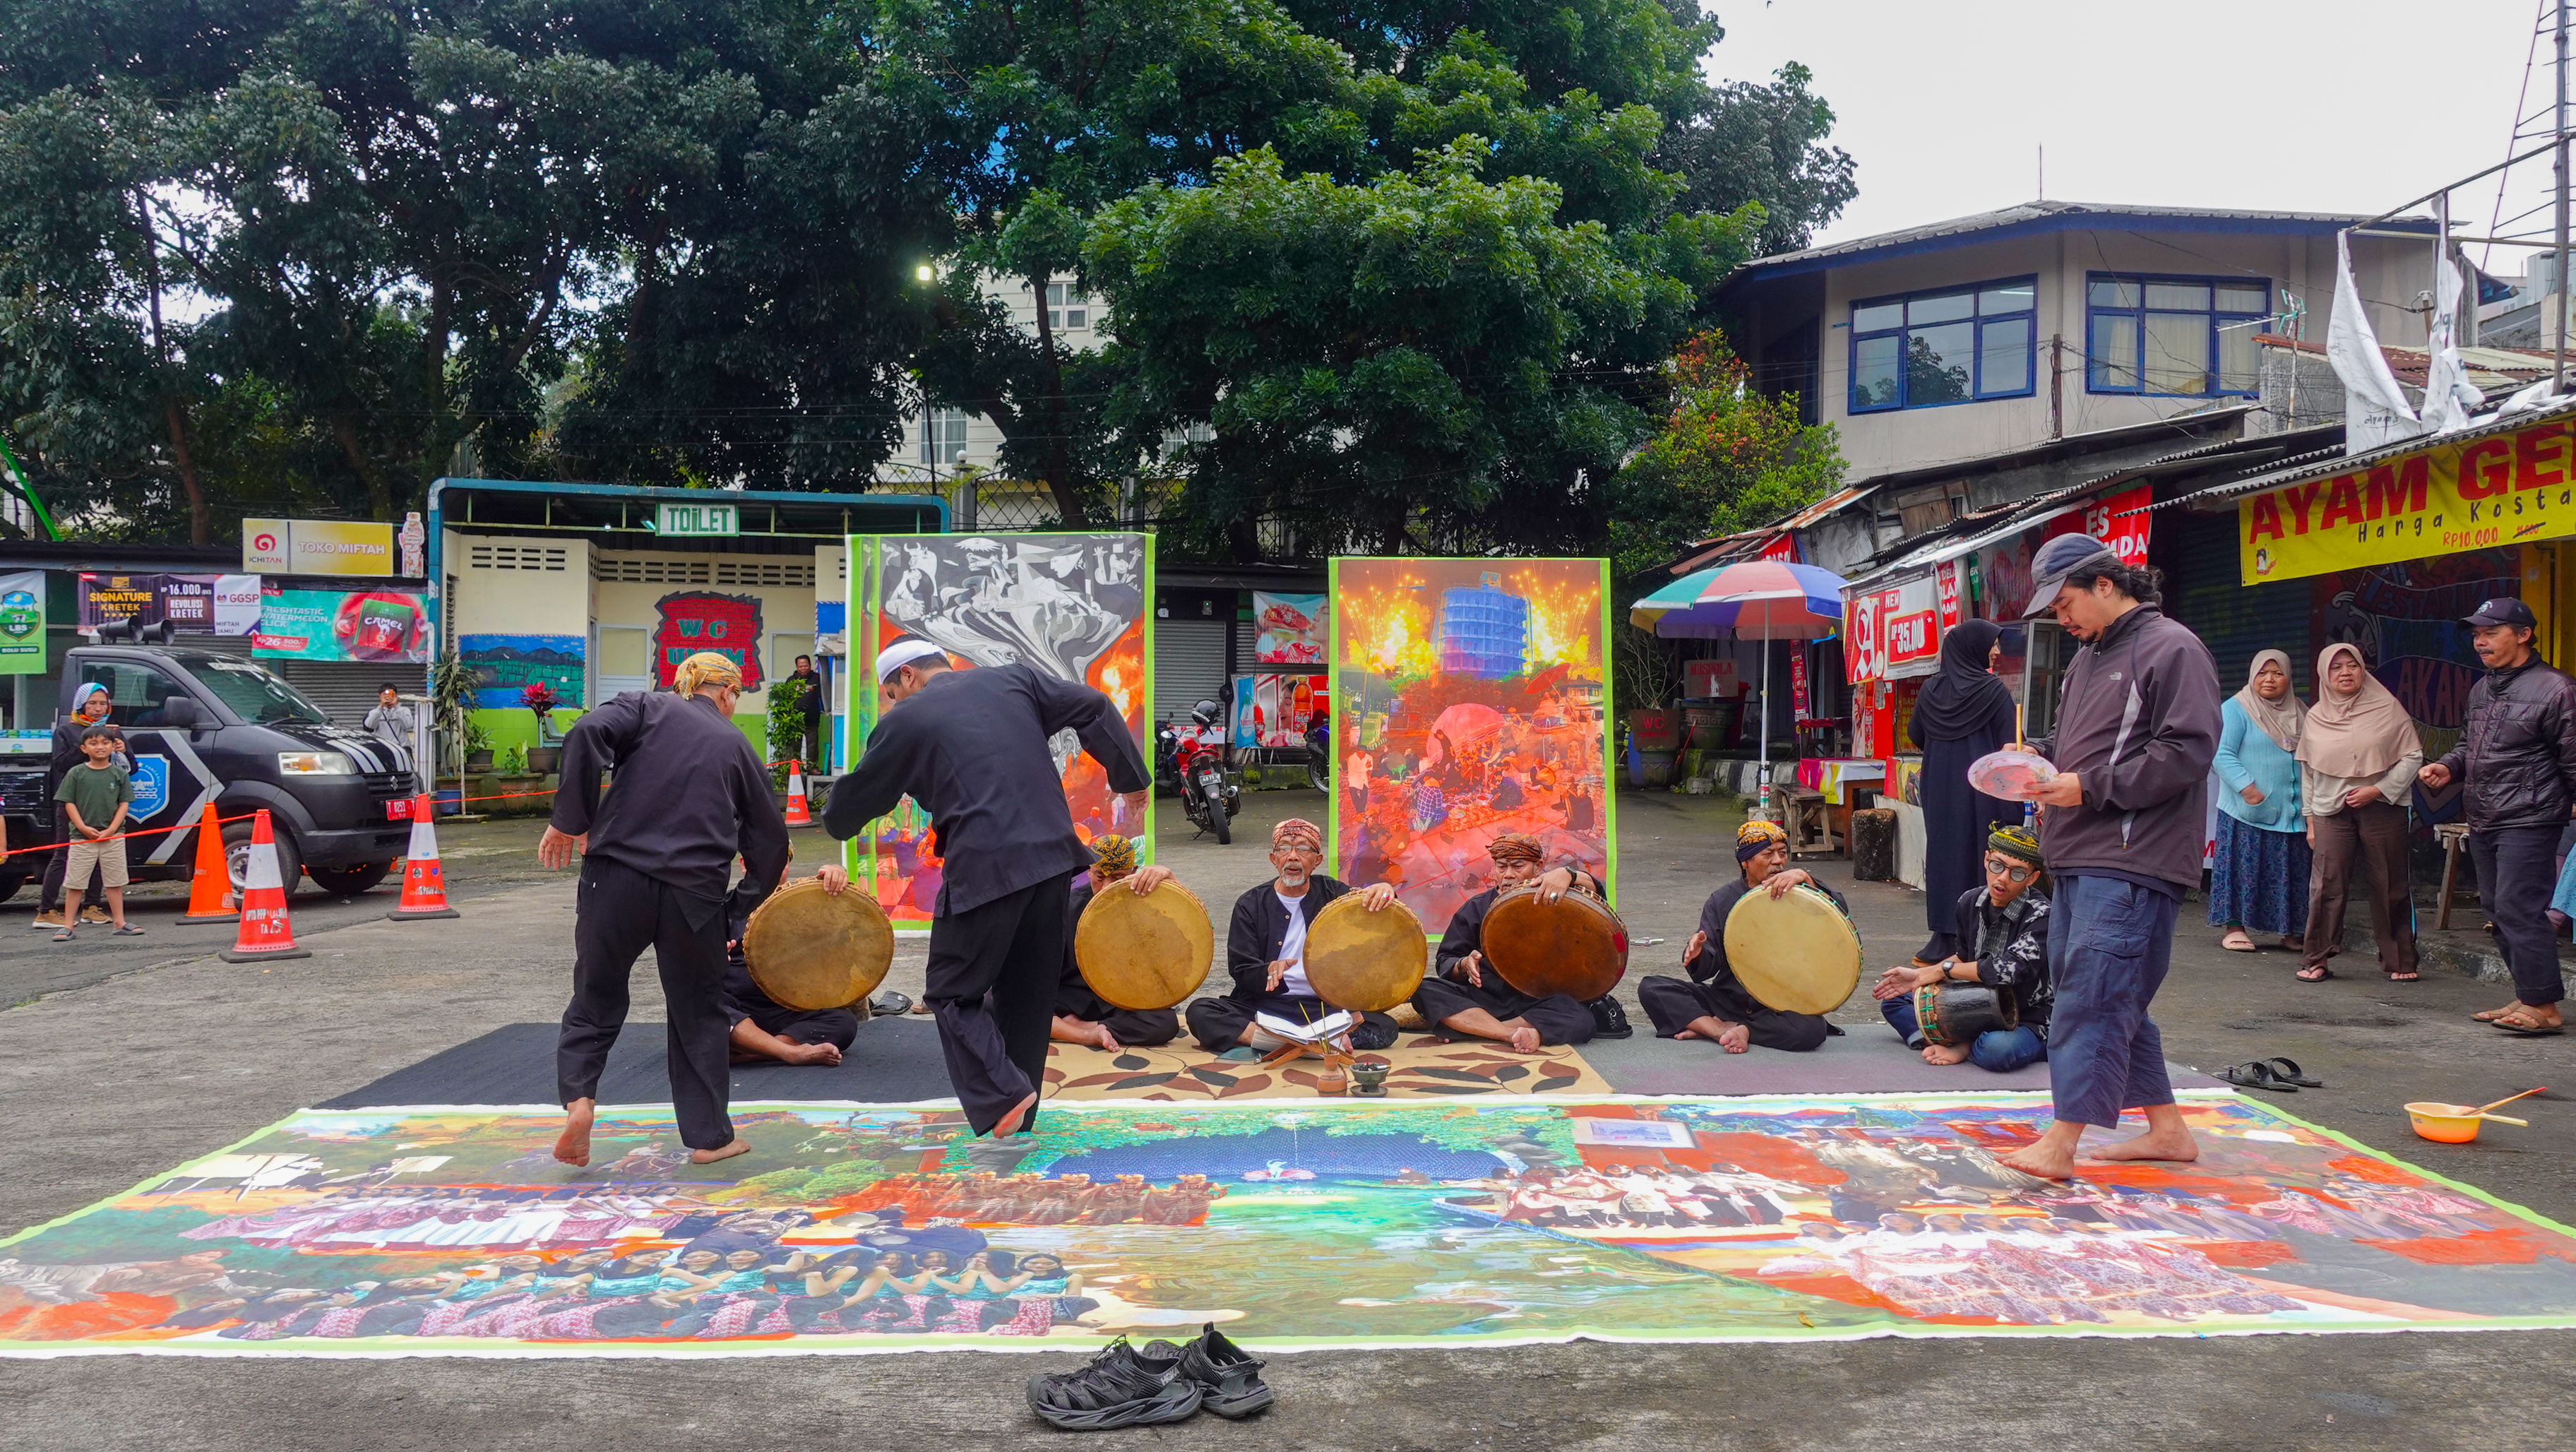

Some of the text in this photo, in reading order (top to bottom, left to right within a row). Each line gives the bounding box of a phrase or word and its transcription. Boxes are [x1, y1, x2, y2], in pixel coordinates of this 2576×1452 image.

[2249, 419, 2576, 544] AYAM GE
[2086, 506, 2109, 539] ES
[2359, 513, 2443, 543] Harga
[299, 542, 386, 555] TOKO MIFTAH
[169, 584, 201, 595] 16.000
[89, 593, 153, 602] SIGNATURE
[170, 599, 203, 608] REVOLUSI
[229, 594, 259, 603] GGSP
[170, 609, 203, 618] KRETEK
[261, 605, 325, 615] FRESHTASTIC
[261, 613, 328, 623] WATERMELON
[364, 617, 402, 631] CAMEL
[667, 648, 745, 666] UM
[1642, 717, 1664, 729] WC
[1160, 1367, 1180, 1386] HOKA
